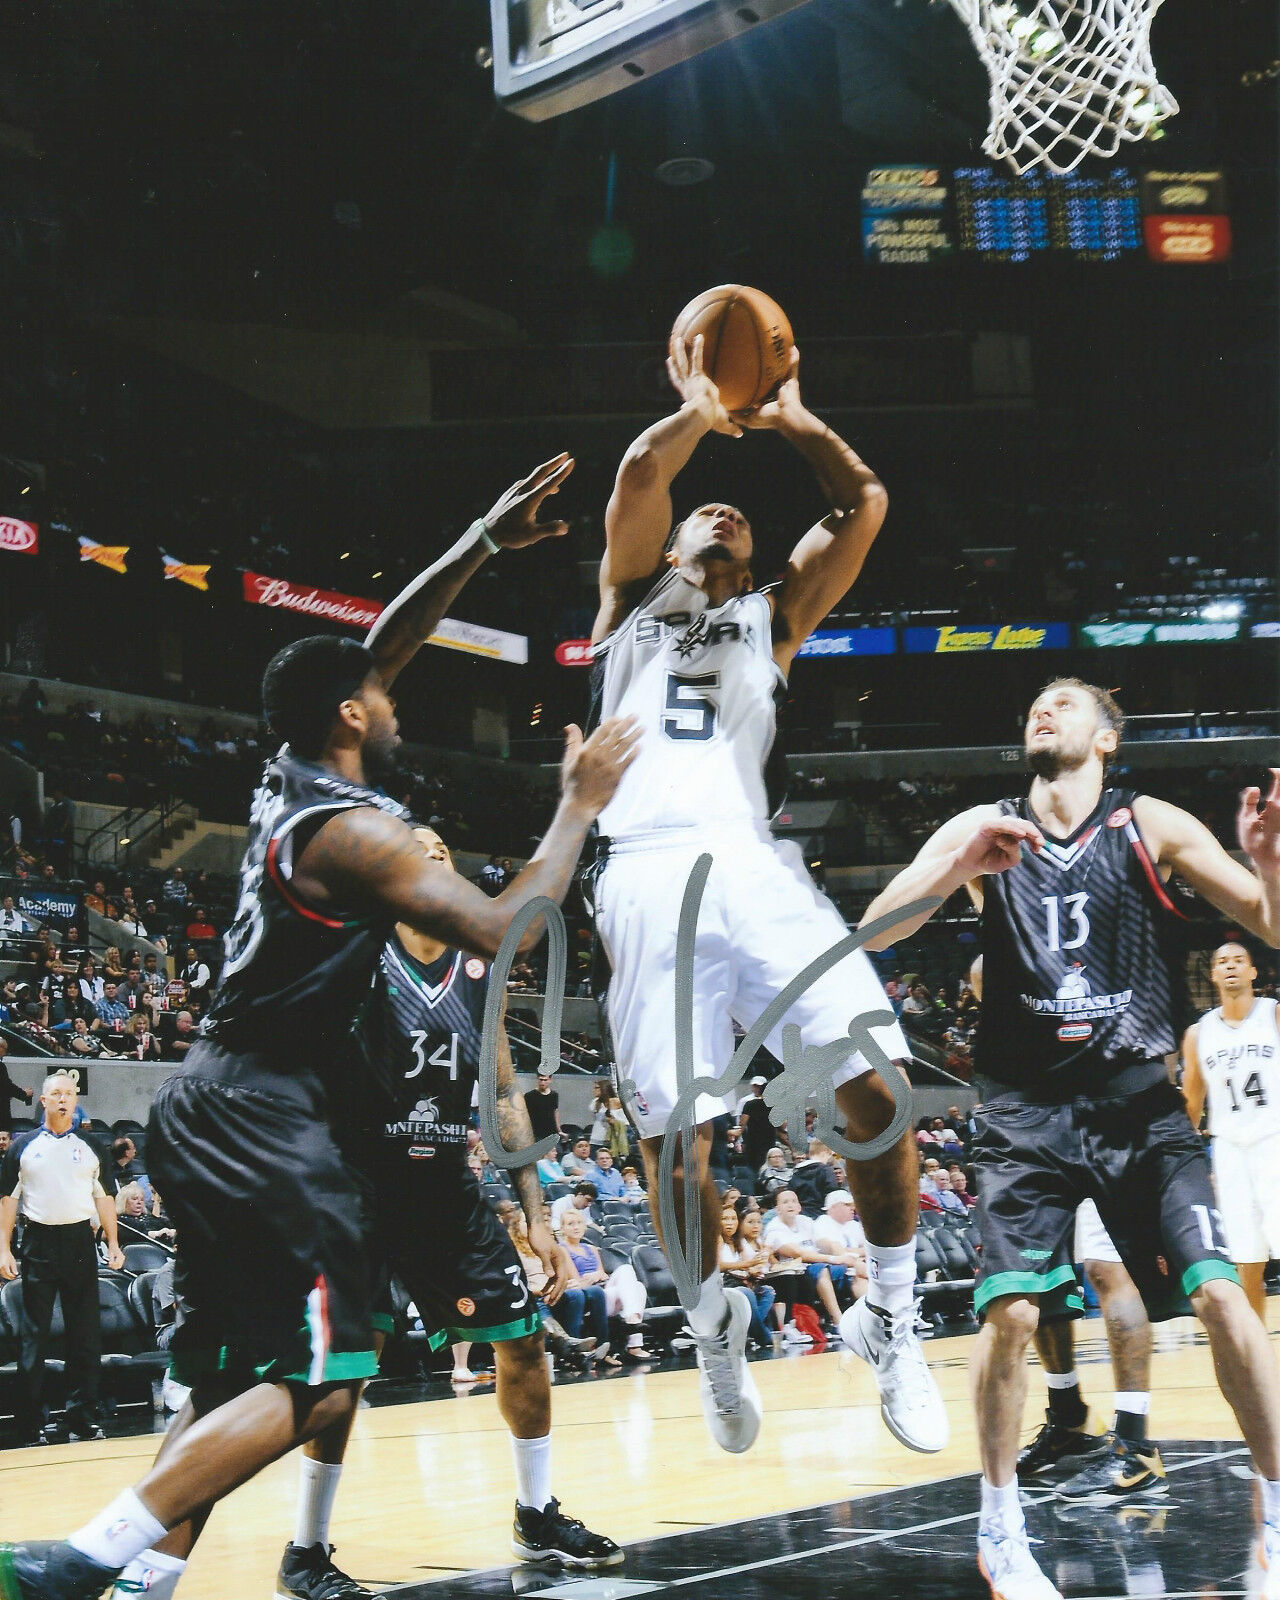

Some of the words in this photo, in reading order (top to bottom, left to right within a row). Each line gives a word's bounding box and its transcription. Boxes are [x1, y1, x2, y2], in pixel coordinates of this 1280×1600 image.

[254, 577, 377, 624] Budweiser
[663, 669, 720, 741] 5
[19, 897, 76, 917] Academy
[1041, 892, 1090, 951] 13
[404, 1030, 458, 1081] 34
[1206, 1044, 1275, 1069] SPURS
[1225, 1072, 1269, 1111] 14
[504, 1264, 529, 1309] 3
